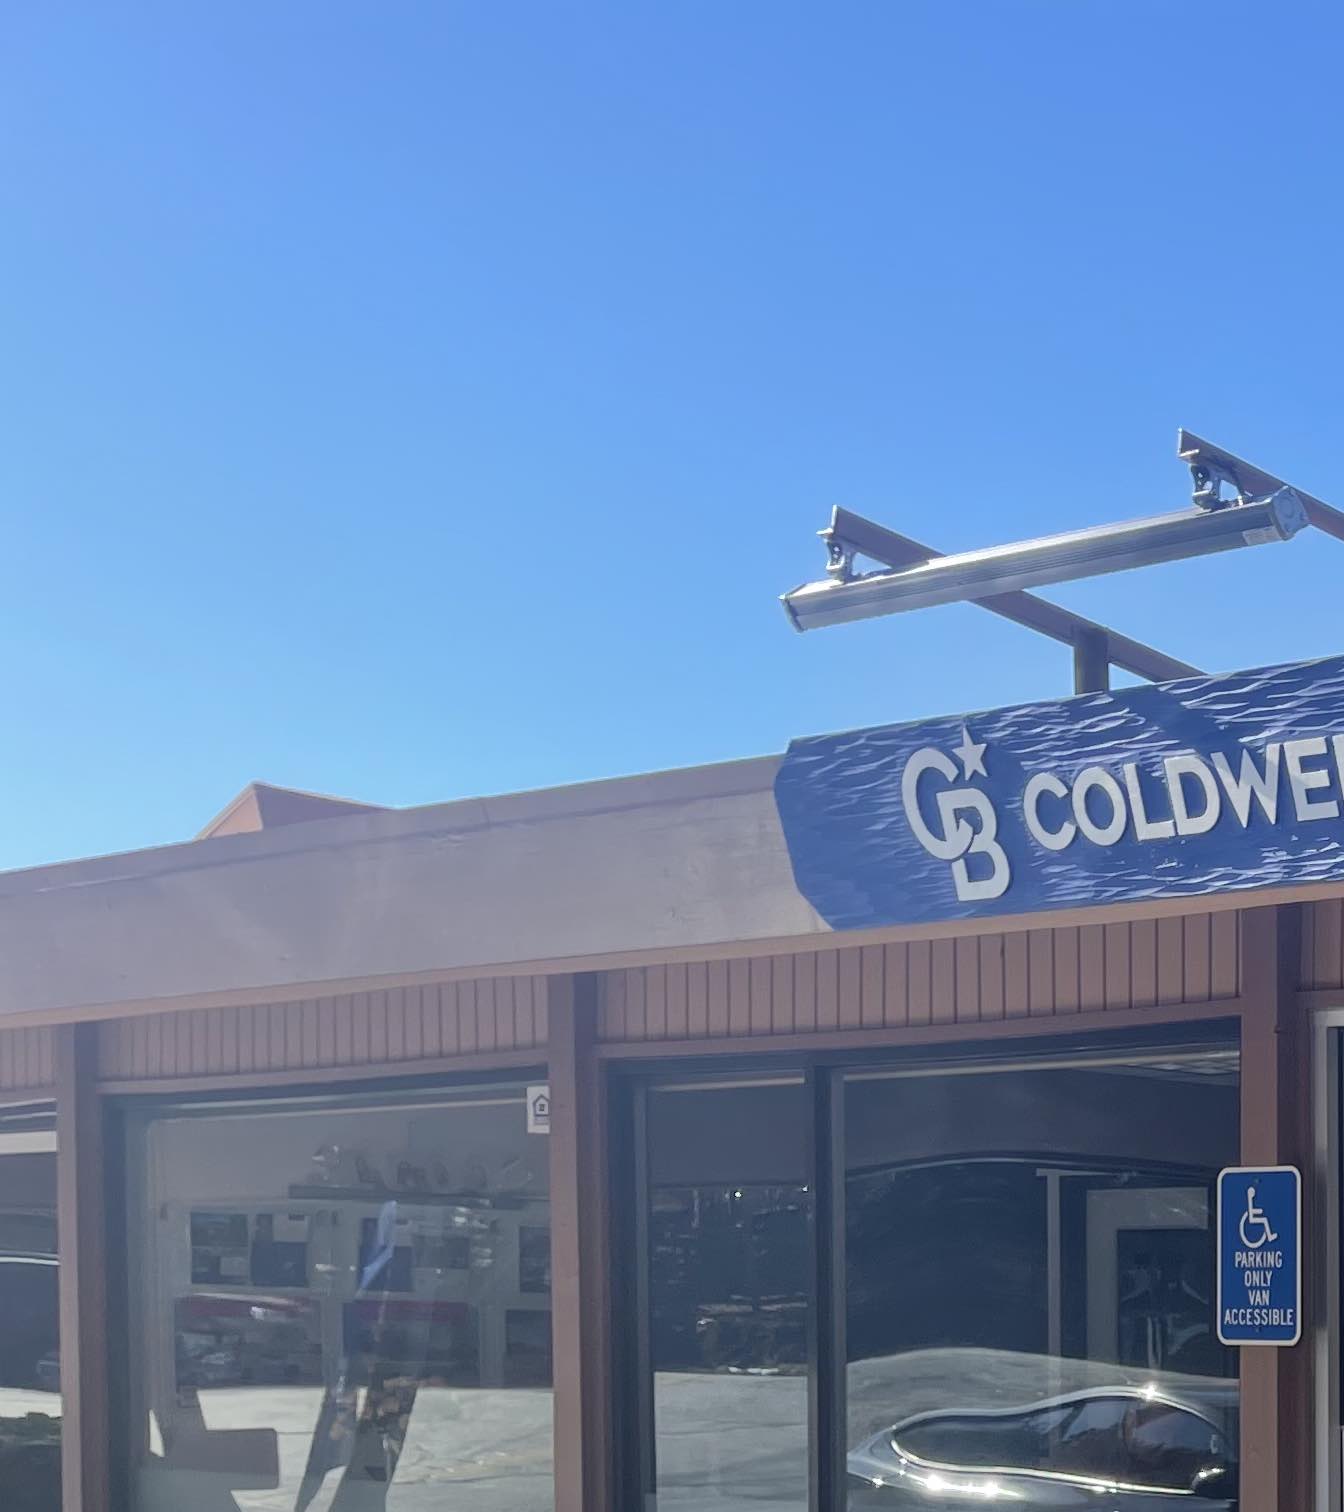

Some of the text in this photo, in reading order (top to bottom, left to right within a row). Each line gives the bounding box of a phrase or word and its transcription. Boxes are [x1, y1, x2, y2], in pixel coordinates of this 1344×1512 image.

[1234, 1251, 1283, 1269] PARKING
[1244, 1270, 1273, 1288] ONLY
[1248, 1289, 1270, 1307] VAN
[1223, 1308, 1294, 1327] ACCESSIBLE
